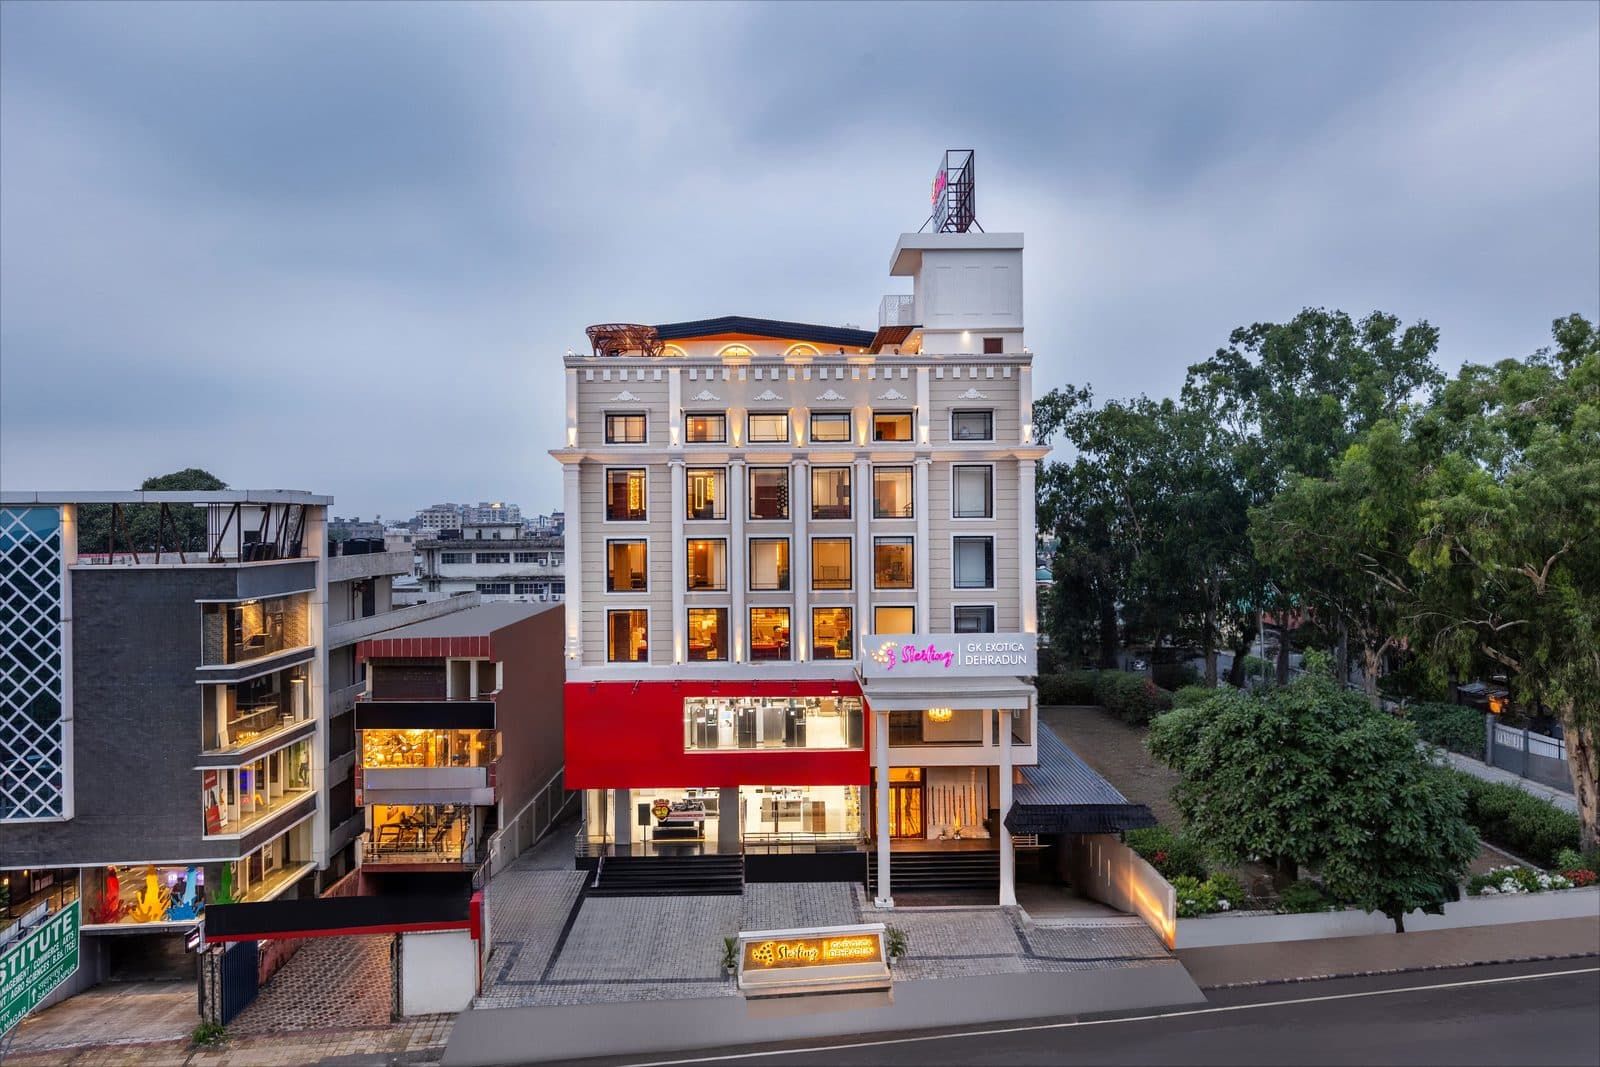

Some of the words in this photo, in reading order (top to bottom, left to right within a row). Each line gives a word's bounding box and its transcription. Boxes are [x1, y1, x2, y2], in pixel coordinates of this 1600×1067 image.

[902, 643, 954, 669] Sterling
[965, 655, 1027, 665] DEHRADUN
[967, 643, 982, 652] GK
[985, 643, 1025, 652] EXOTICA
[33, 941, 60, 970] COMMERCE
[63, 930, 73, 946] ARTS
[778, 943, 818, 962] Sterling
[11, 980, 25, 1001] AGRO
[26, 960, 49, 987] SCIENCES
[4, 1006, 26, 1032] NAGAR
